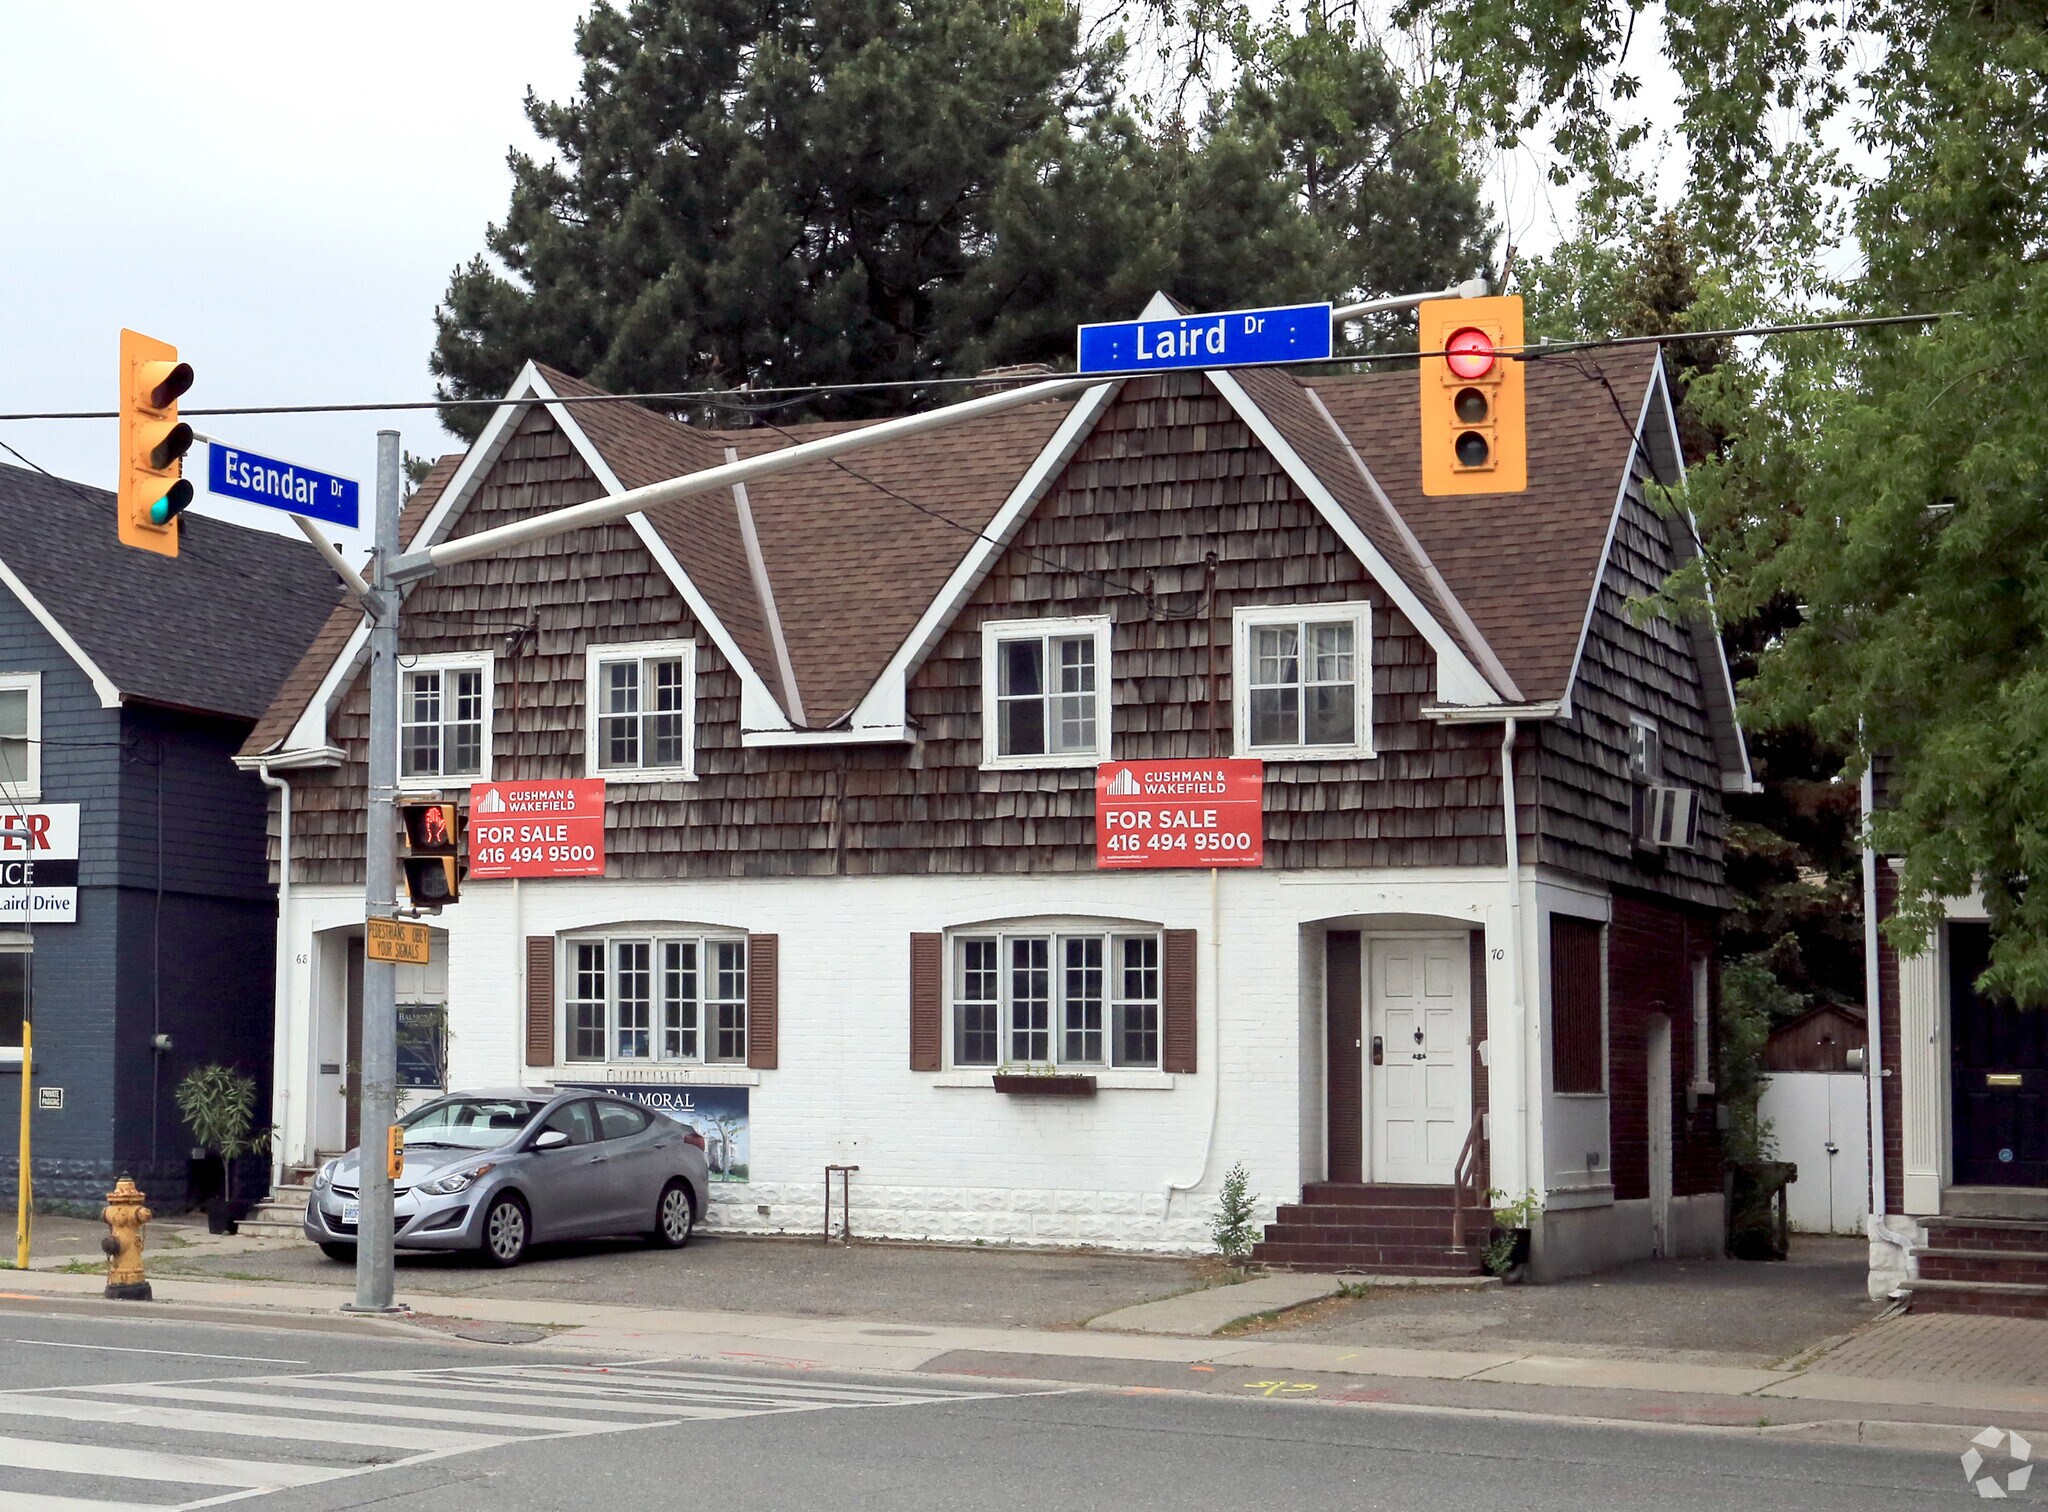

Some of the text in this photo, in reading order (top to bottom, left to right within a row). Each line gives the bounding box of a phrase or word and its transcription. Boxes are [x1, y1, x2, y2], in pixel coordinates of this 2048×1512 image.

[1136, 316, 1265, 361] Laird Dr
[225, 450, 343, 506] Esandar Dr
[1144, 770, 1226, 783] CUSHMAN &
[508, 789, 575, 802] CUSHMAN &
[1144, 782, 1226, 795] WAKEFIELD
[508, 800, 576, 812] WAKEFIELD
[1106, 809, 1218, 830] FOR SALE
[0, 814, 52, 851] ER
[477, 825, 568, 844] FOR SALE
[1106, 832, 1251, 851] 416 494 9500
[477, 845, 595, 864] 416 494 9500
[34, 895, 70, 911] Drive
[368, 922, 428, 944] PEDESTRIANS OBEY
[296, 953, 308, 965] 68
[377, 940, 419, 960] YOUR SIGNALS
[1491, 948, 1505, 961] 70
